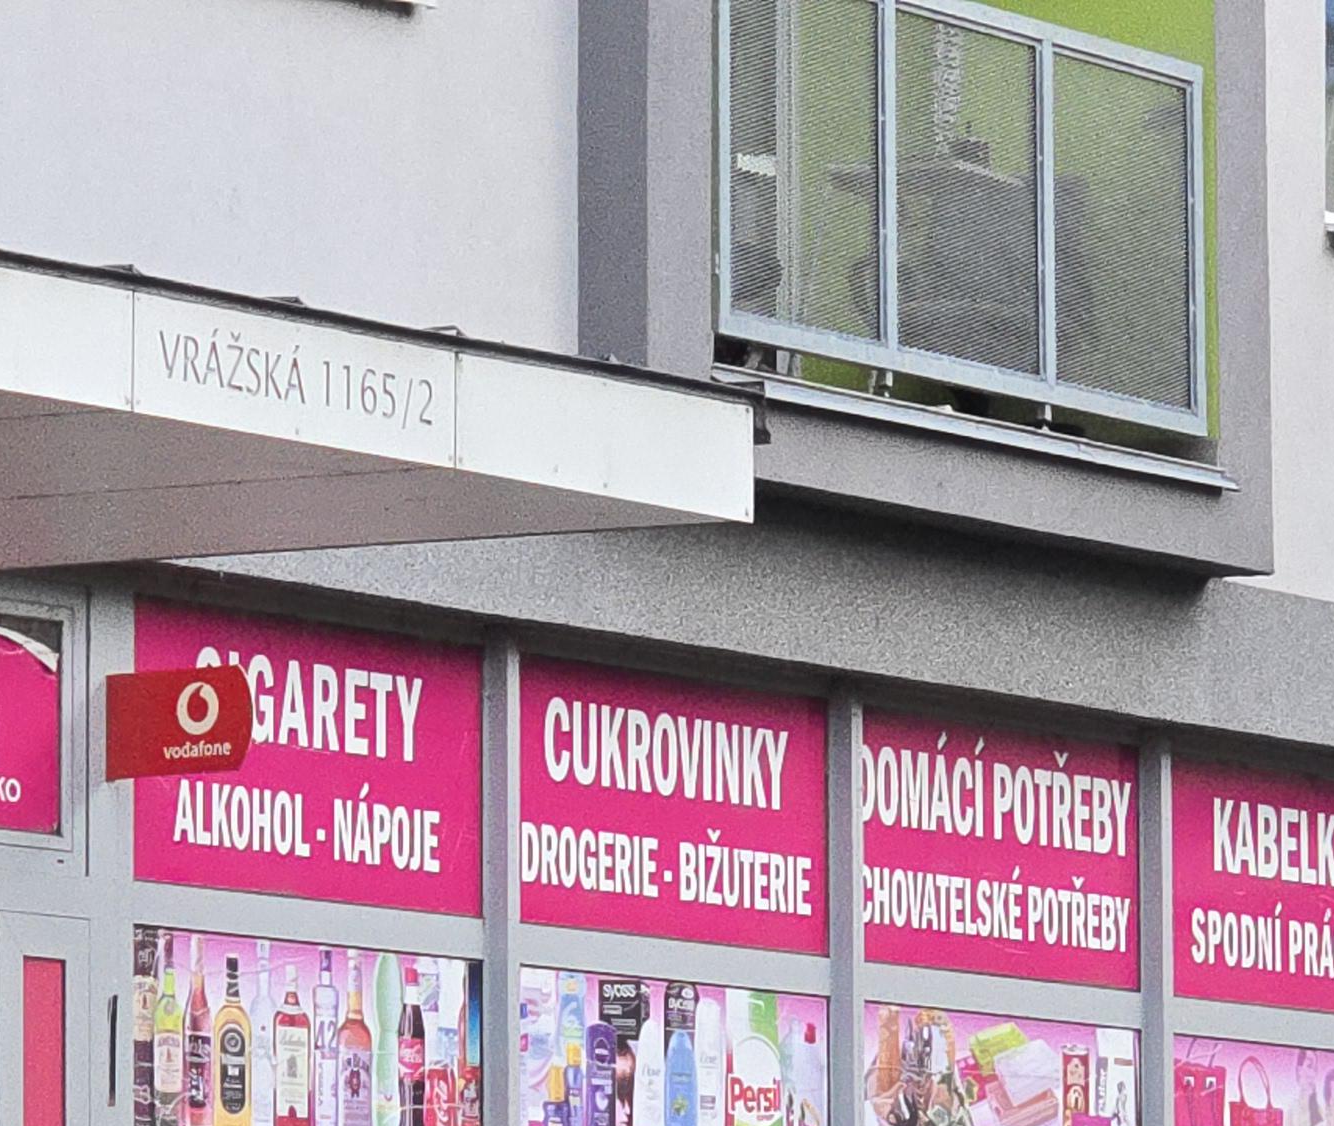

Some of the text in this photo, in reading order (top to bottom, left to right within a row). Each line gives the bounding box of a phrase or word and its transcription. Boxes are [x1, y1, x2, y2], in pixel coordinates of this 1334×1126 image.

[159, 328, 434, 430] VRÁŽSKÁ 1165/2
[163, 740, 232, 759] vodafone
[196, 646, 423, 763] GARETY
[543, 696, 789, 811] CUKROVINKY
[862, 731, 1131, 857] DOMÁCÍ POTŘEBY
[173, 778, 310, 858] ALKOHOL
[334, 783, 441, 873] NÁPOJE
[520, 822, 659, 898] DROGERIE
[679, 829, 812, 916] BIŽUTERIE
[862, 864, 1130, 953] CHOVATELSKÉ POTŘEBY
[1191, 902, 1283, 974] SPODNÍ
[730, 1076, 781, 1114] Persil
